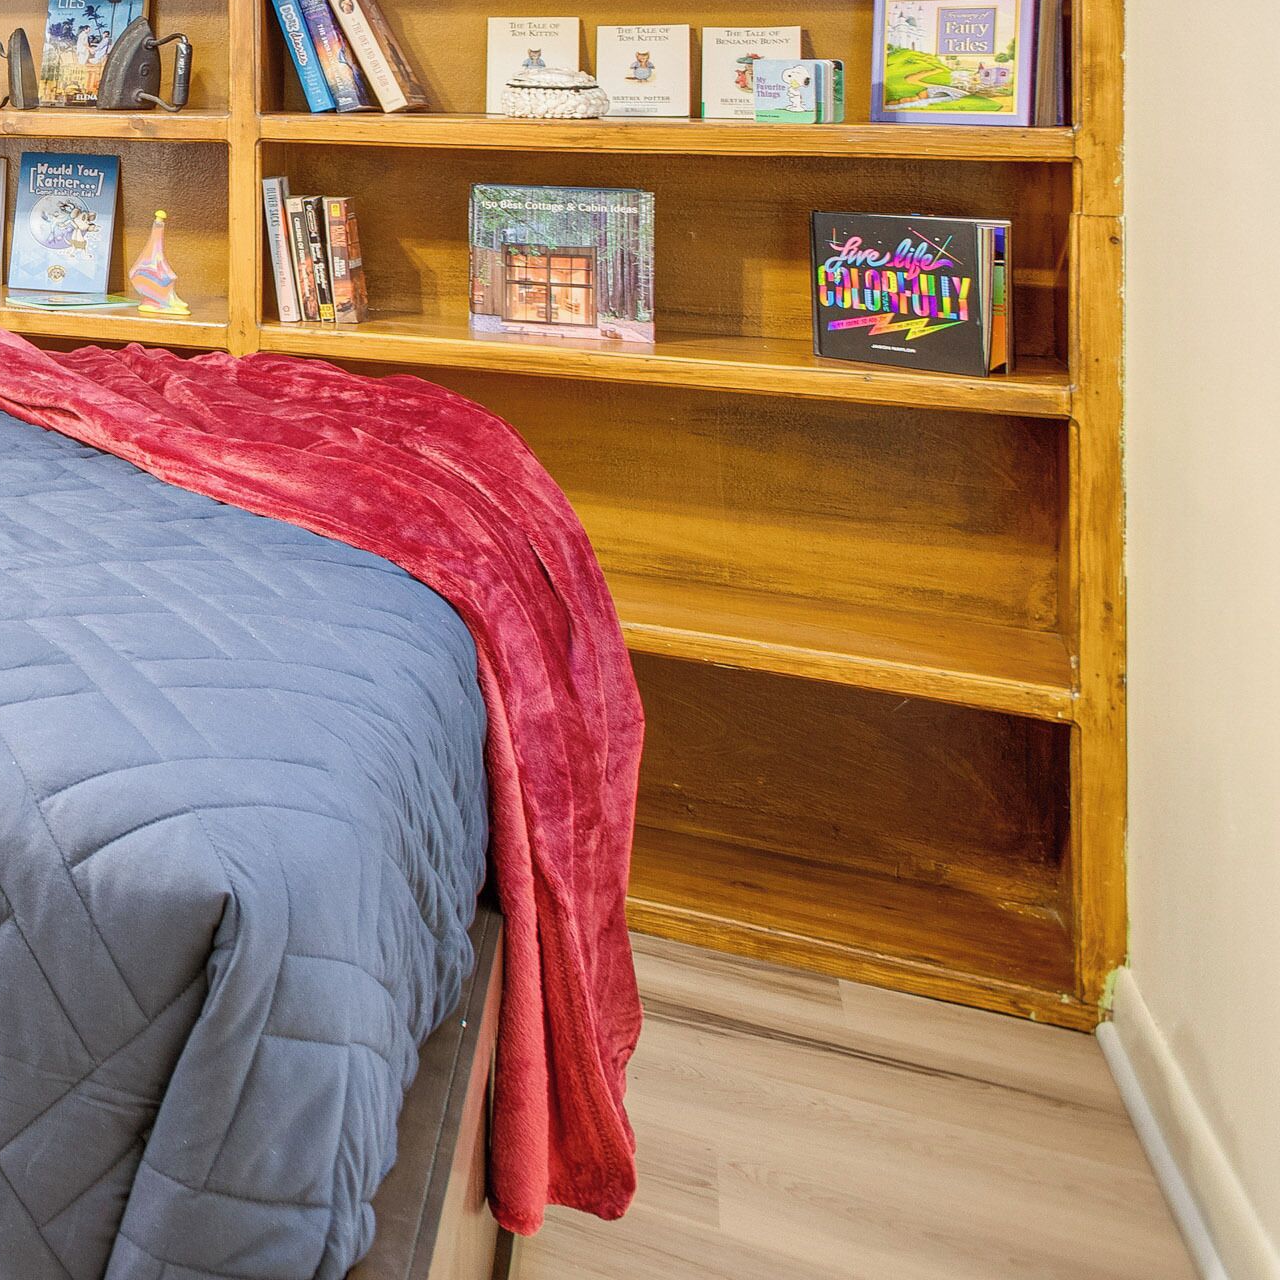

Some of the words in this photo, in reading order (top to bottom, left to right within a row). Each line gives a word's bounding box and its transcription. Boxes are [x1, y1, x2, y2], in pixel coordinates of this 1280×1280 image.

[280, 4, 300, 33] DORK
[351, 22, 362, 34] THE
[510, 29, 526, 37] TOM
[529, 29, 559, 37] KITTEN
[635, 26, 656, 34] TALE
[945, 20, 990, 38] Fairy
[358, 34, 368, 47] ONE
[617, 34, 634, 42] TOM
[944, 37, 988, 52] Tales
[289, 28, 308, 66] diaries
[366, 48, 376, 62] AND
[371, 60, 384, 75] ONLY
[377, 72, 389, 87] BOB
[756, 76, 766, 84] My
[756, 83, 786, 91] Favorite
[756, 90, 781, 98] Things
[37, 163, 73, 175] Would
[77, 164, 98, 177] You
[36, 174, 96, 189] Rather...
[266, 187, 278, 208] OLIVER
[481, 200, 497, 209] 150
[499, 200, 522, 210] Best
[525, 201, 564, 213] Cottage
[566, 204, 576, 212] &
[578, 203, 607, 213] Cabin
[610, 205, 638, 214] Ideas
[269, 209, 280, 228] SACKS
[294, 217, 302, 241] CHILDREN
[825, 236, 890, 273] Live
[886, 238, 954, 280] life
[817, 265, 971, 320] COLORFULLY
